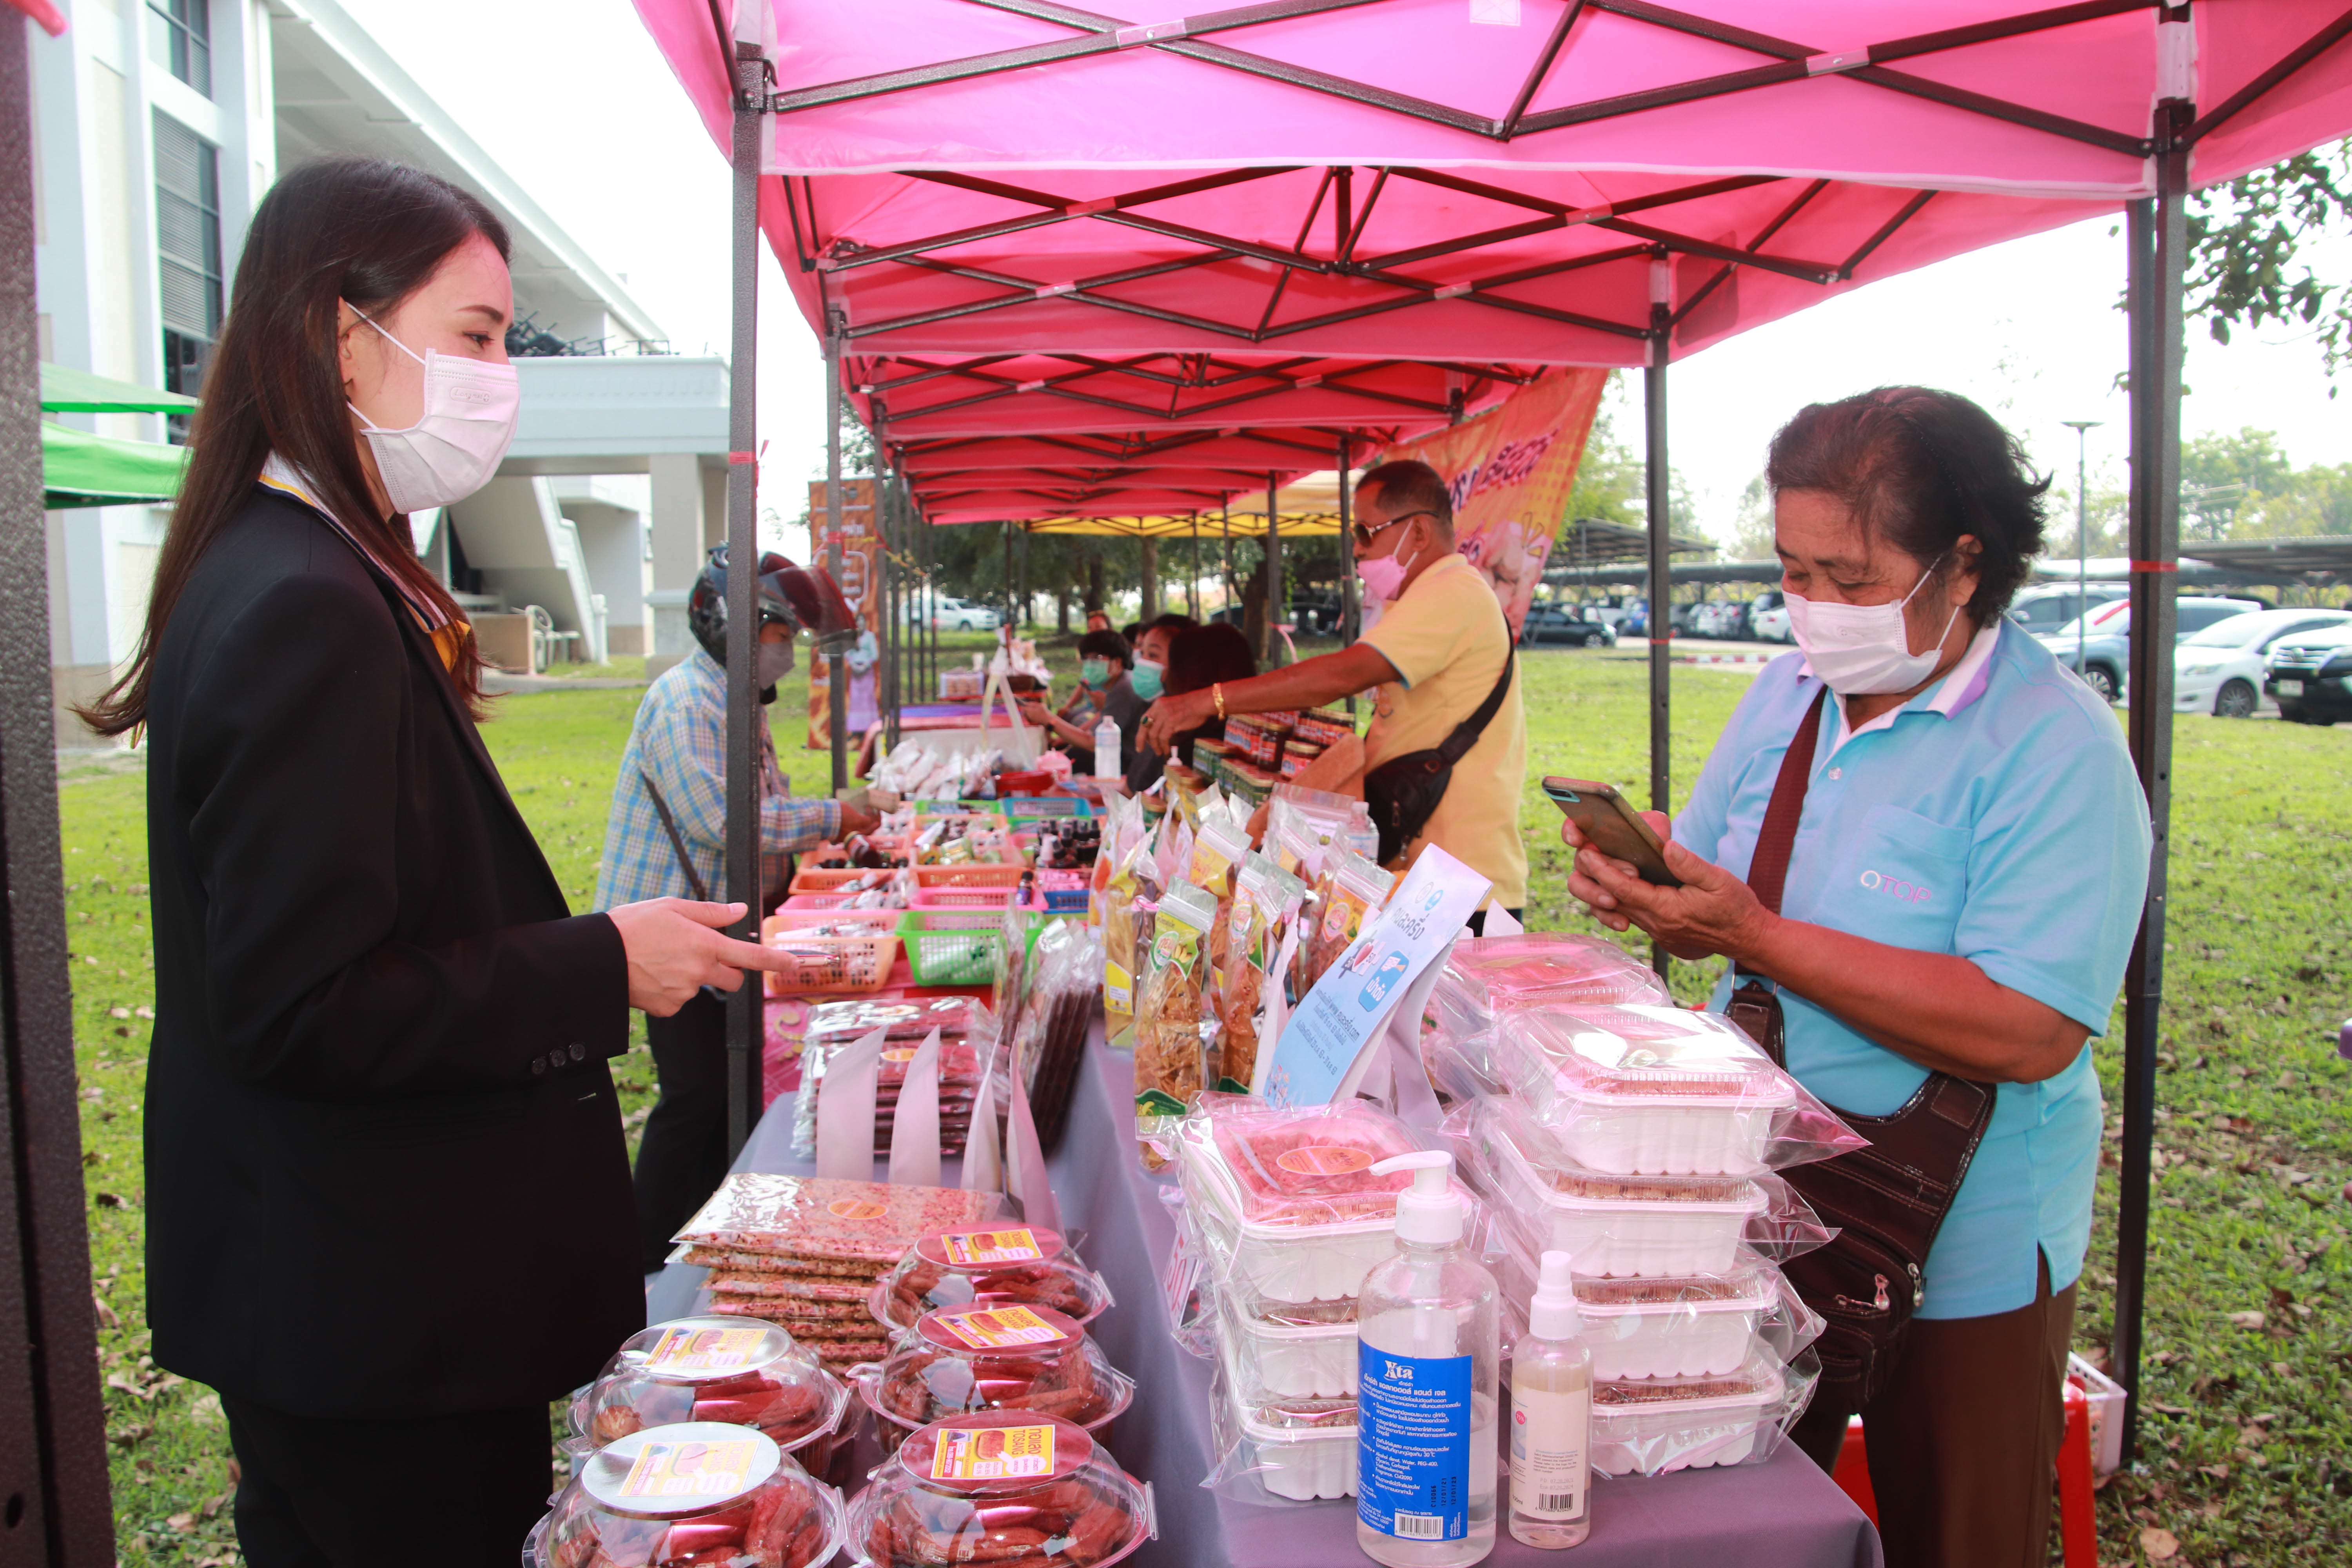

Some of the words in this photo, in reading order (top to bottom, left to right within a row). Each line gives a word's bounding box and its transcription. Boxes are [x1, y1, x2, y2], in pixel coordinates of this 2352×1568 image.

[1860, 870, 1931, 904] OTOP
[1391, 907, 1430, 940] คนละครึ่ง
[993, 1311, 1025, 1328] TOSANG
[1379, 1382, 1412, 1395] แอลกอฮอล์
[1011, 1429, 1025, 1455] TOSANG
[1027, 1428, 1042, 1454] ทอแสง
[706, 1443, 730, 1471] TOSANG
[1376, 1452, 1388, 1460] Alcohol
